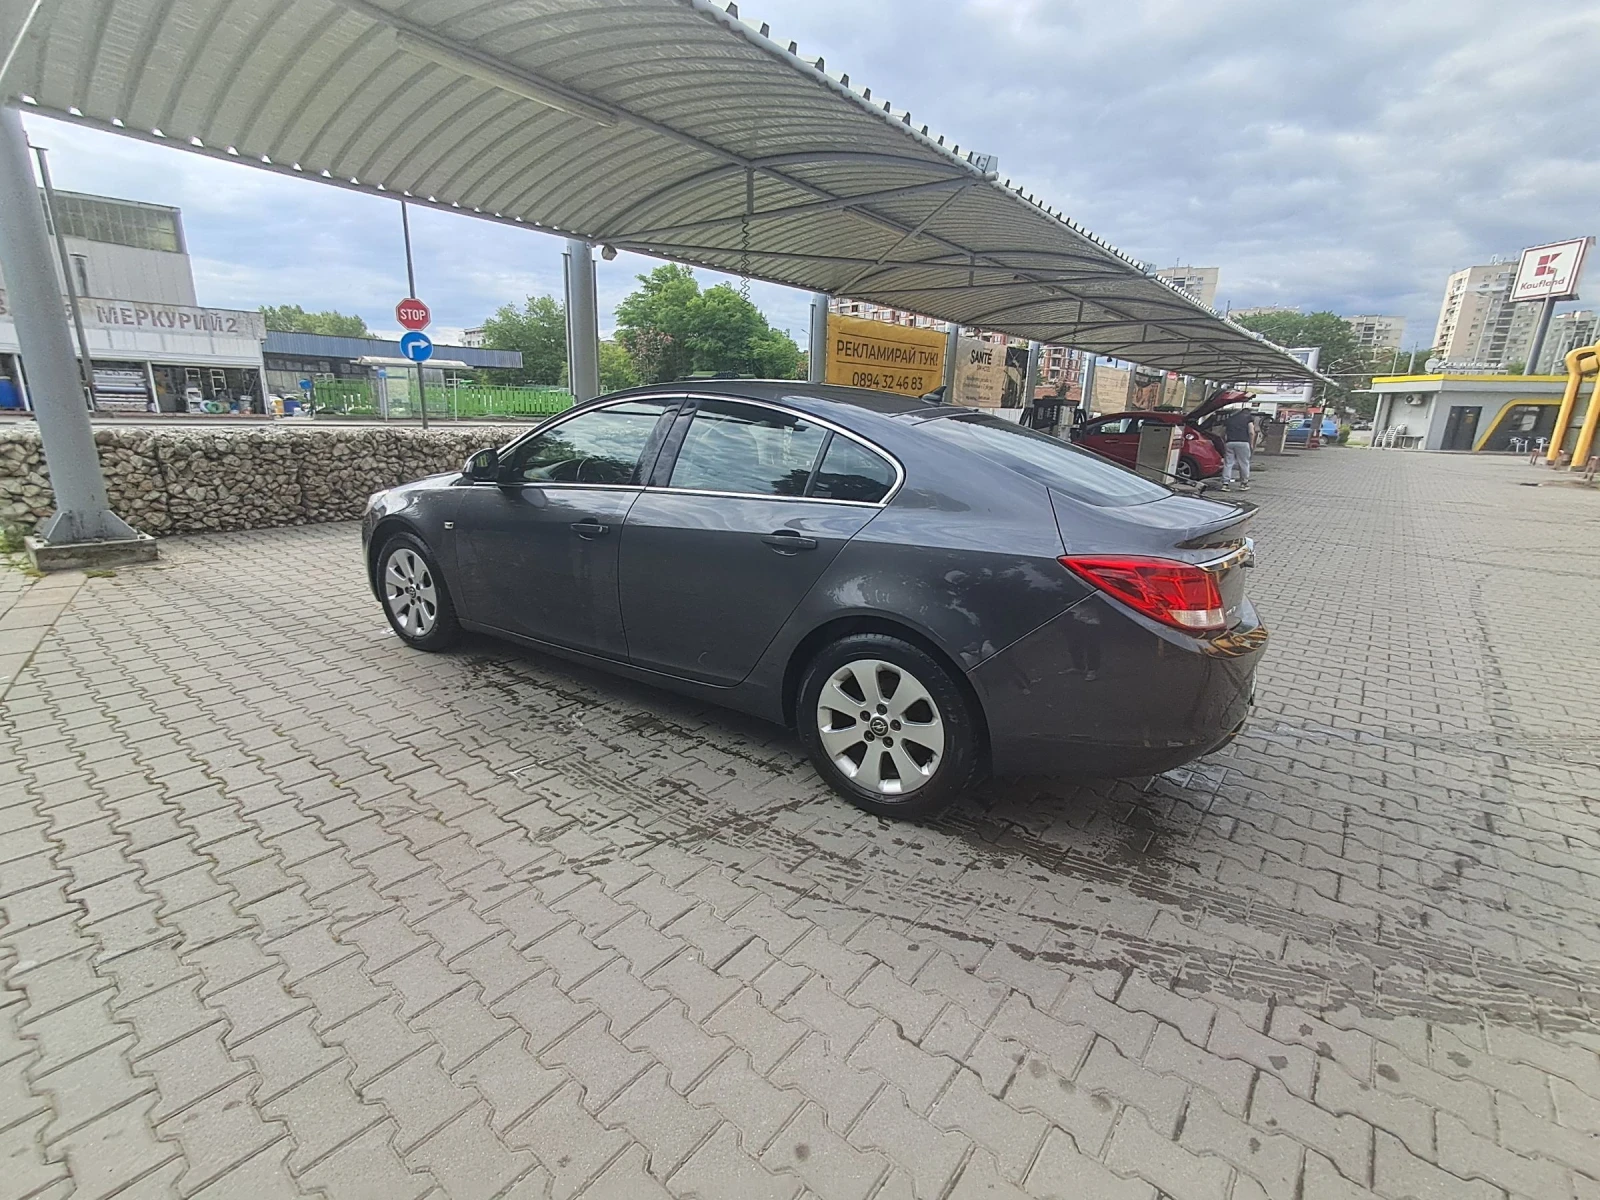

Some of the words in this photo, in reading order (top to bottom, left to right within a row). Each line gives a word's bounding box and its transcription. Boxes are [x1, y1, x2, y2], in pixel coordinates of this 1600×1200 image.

[1520, 277, 1565, 290] Kaufland
[400, 308, 426, 321] STOP
[836, 340, 916, 364] РЕКЛАМИРАЙ
[918, 351, 939, 366] ТУК!
[970, 348, 993, 365] SANTÉ
[852, 371, 880, 388] 0894
[882, 374, 894, 389] 32
[896, 375, 909, 390] 46
[911, 376, 923, 390] 83
